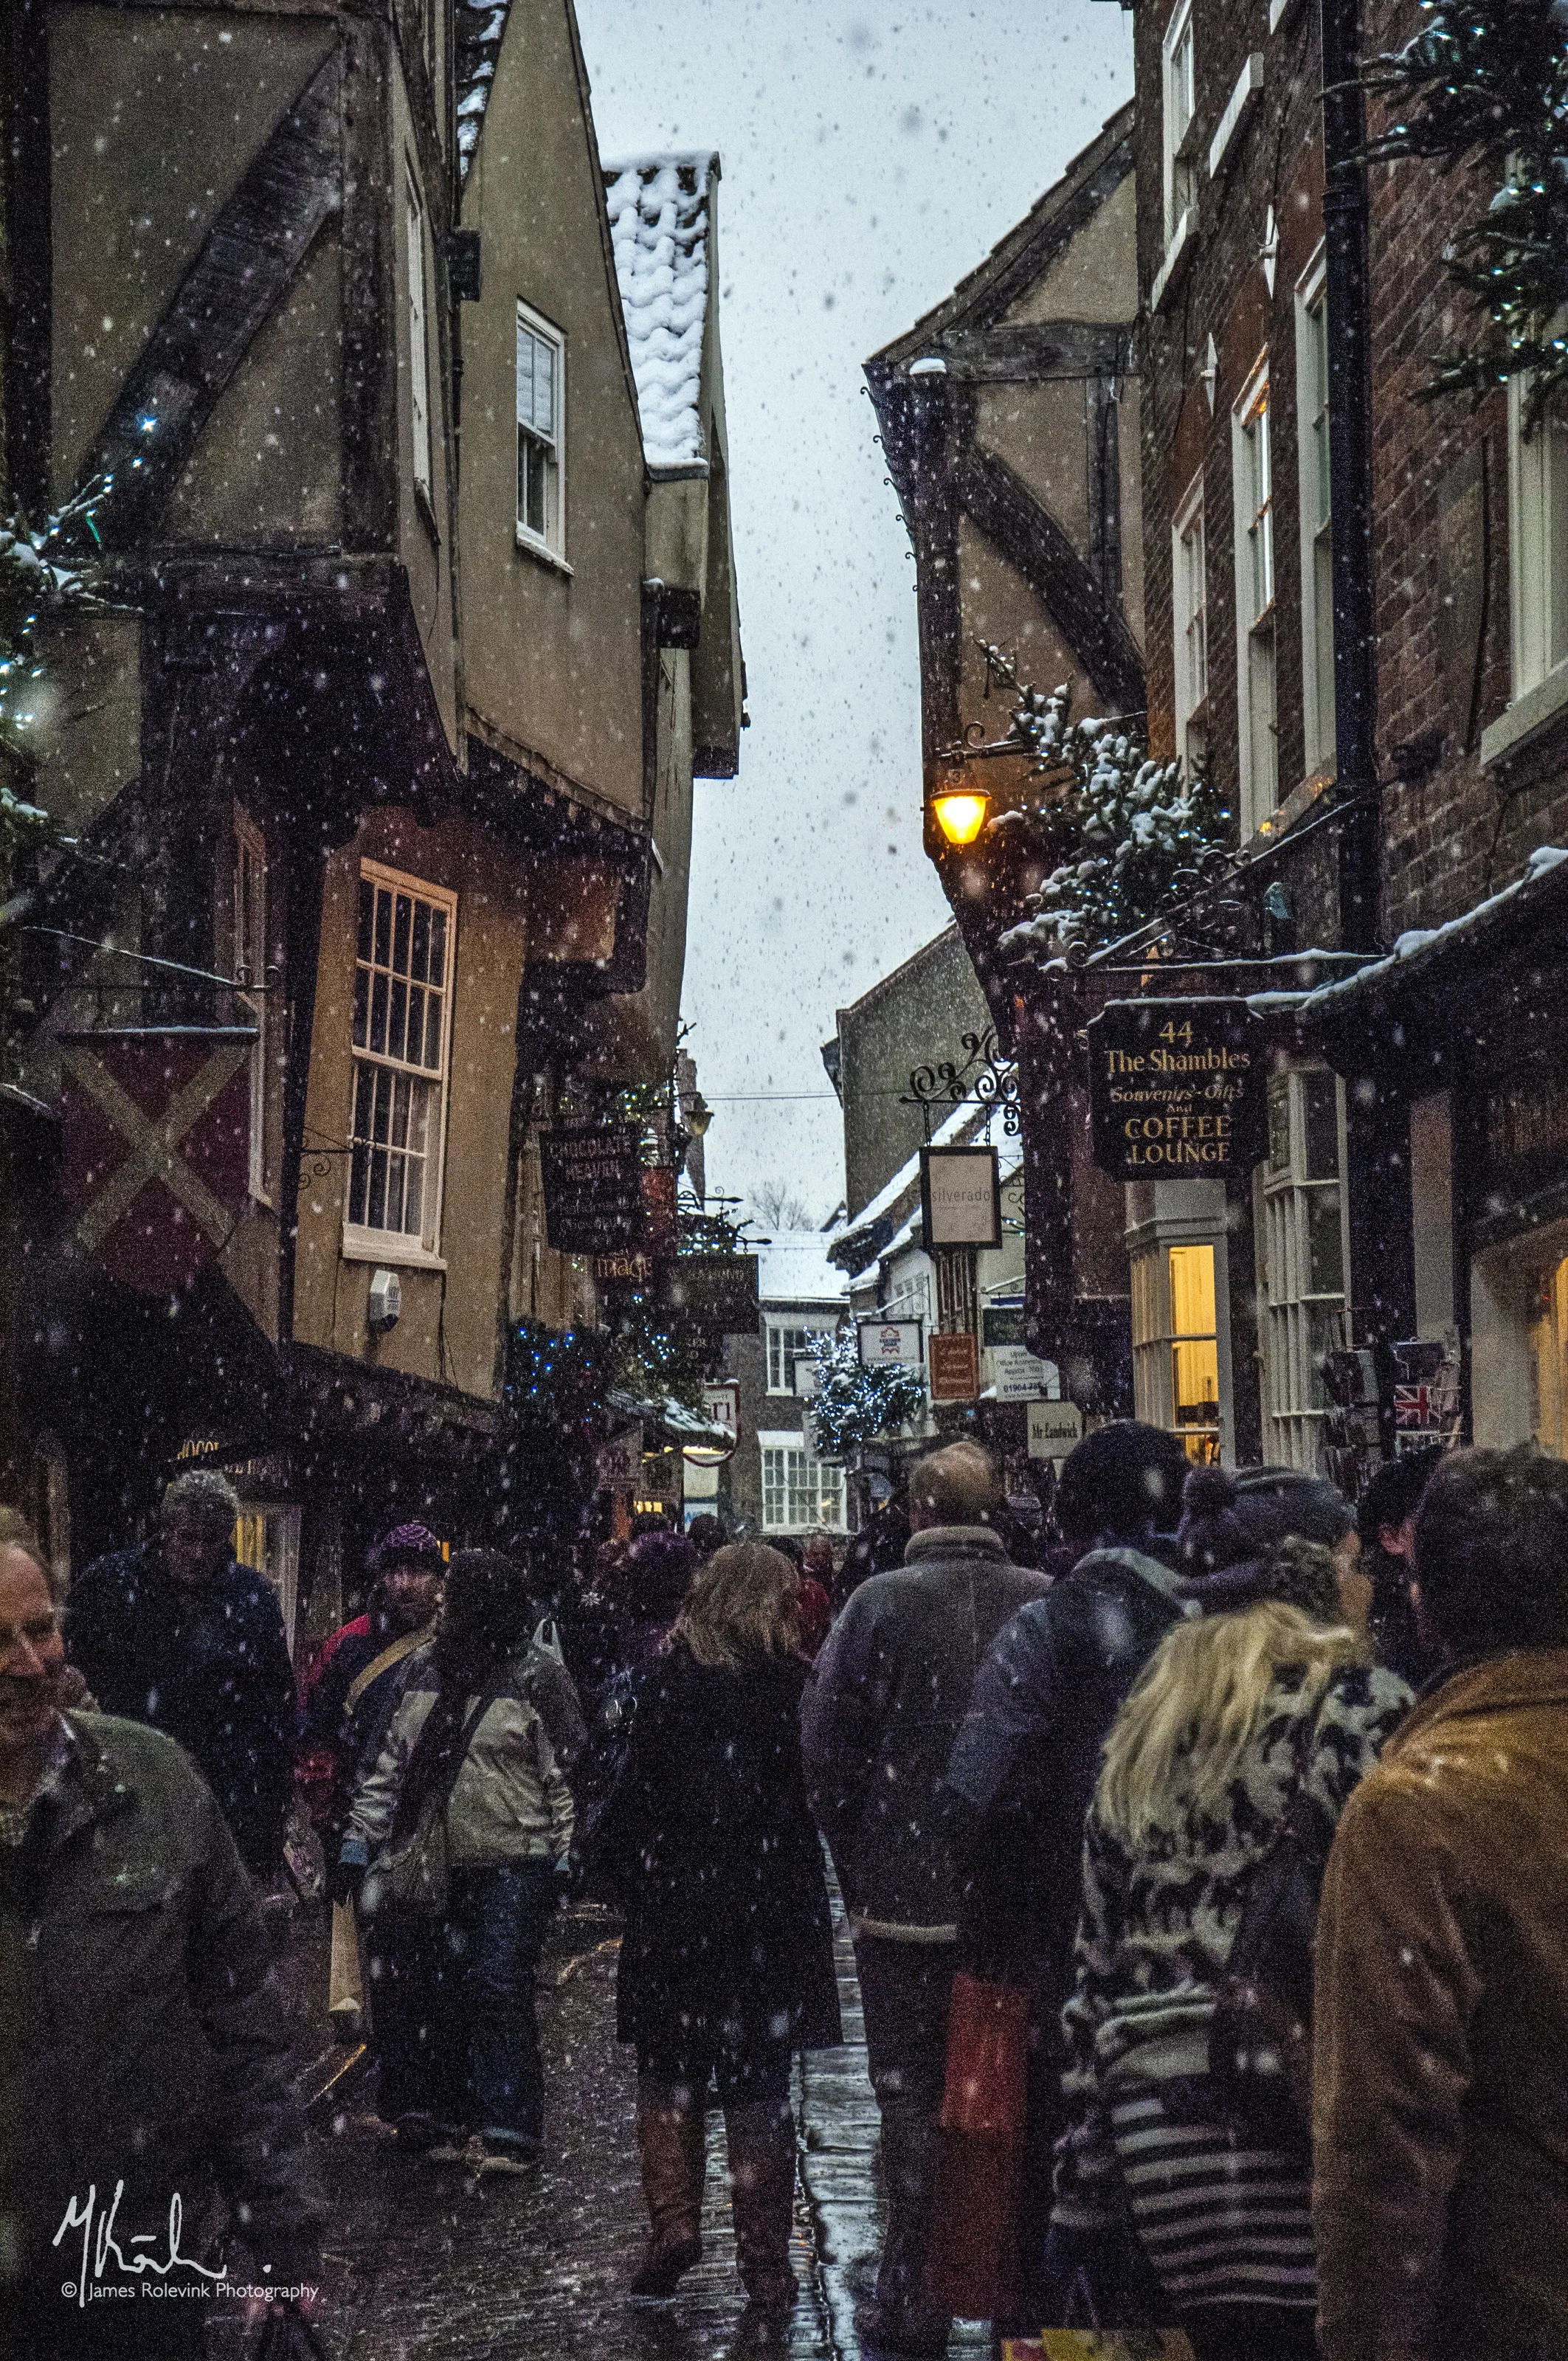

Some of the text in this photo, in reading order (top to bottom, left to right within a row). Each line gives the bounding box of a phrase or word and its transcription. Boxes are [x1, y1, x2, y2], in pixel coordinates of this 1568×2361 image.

[1159, 1021, 1193, 1045] 44
[1105, 1047, 1251, 1073] The Shambles
[1125, 1116, 1232, 1139] COFFEE
[546, 1135, 632, 1158] CHOCOLATE
[1130, 1141, 1231, 1164] LOUNGE
[931, 1186, 991, 1203] silverado
